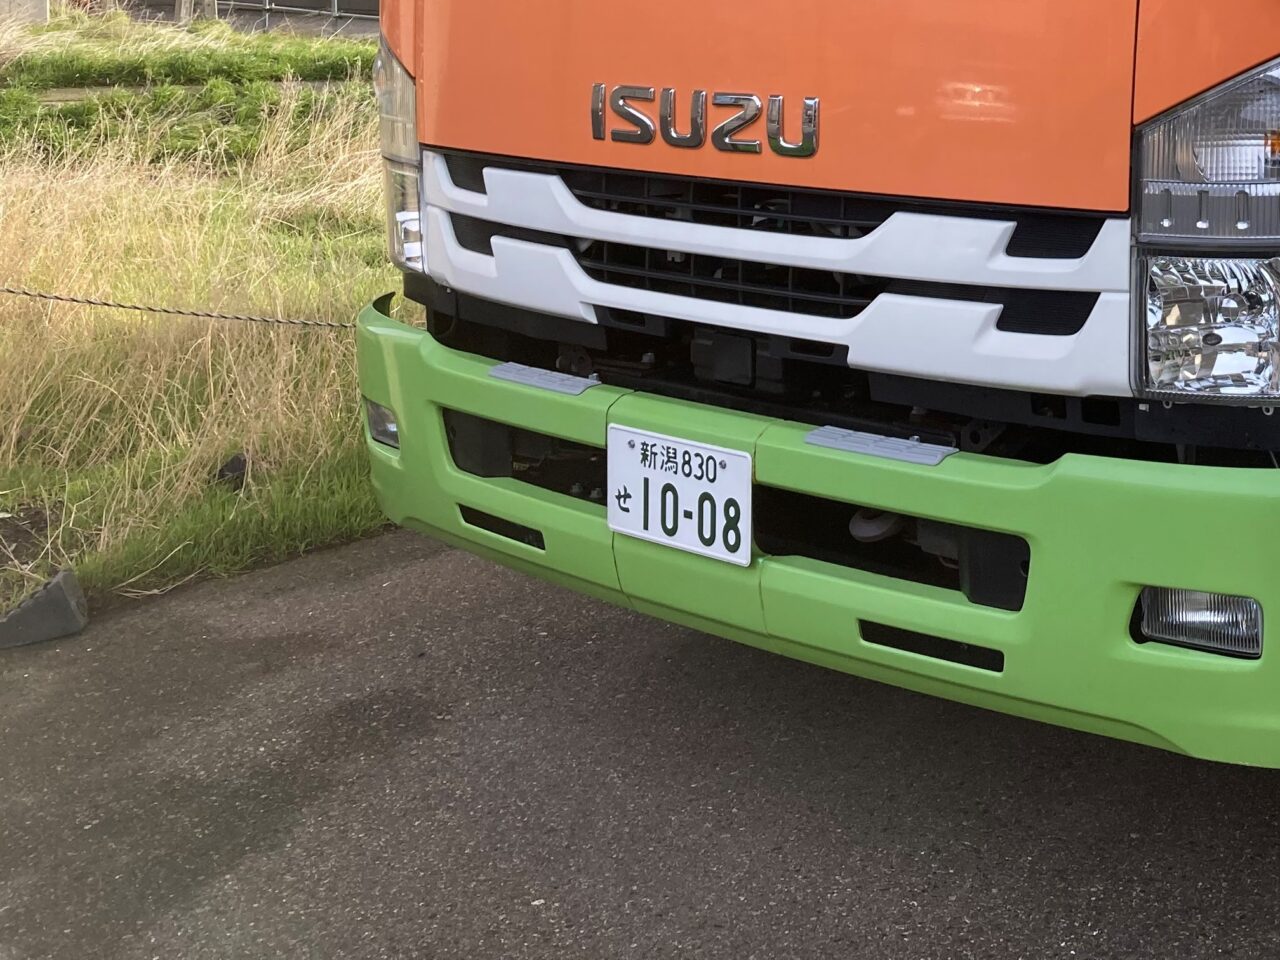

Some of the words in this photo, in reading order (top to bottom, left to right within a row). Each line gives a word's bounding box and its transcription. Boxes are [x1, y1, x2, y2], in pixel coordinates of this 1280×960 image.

[591, 82, 819, 158] ISUZU
[615, 485, 633, 514] せ
[643, 476, 742, 554] 10-08
